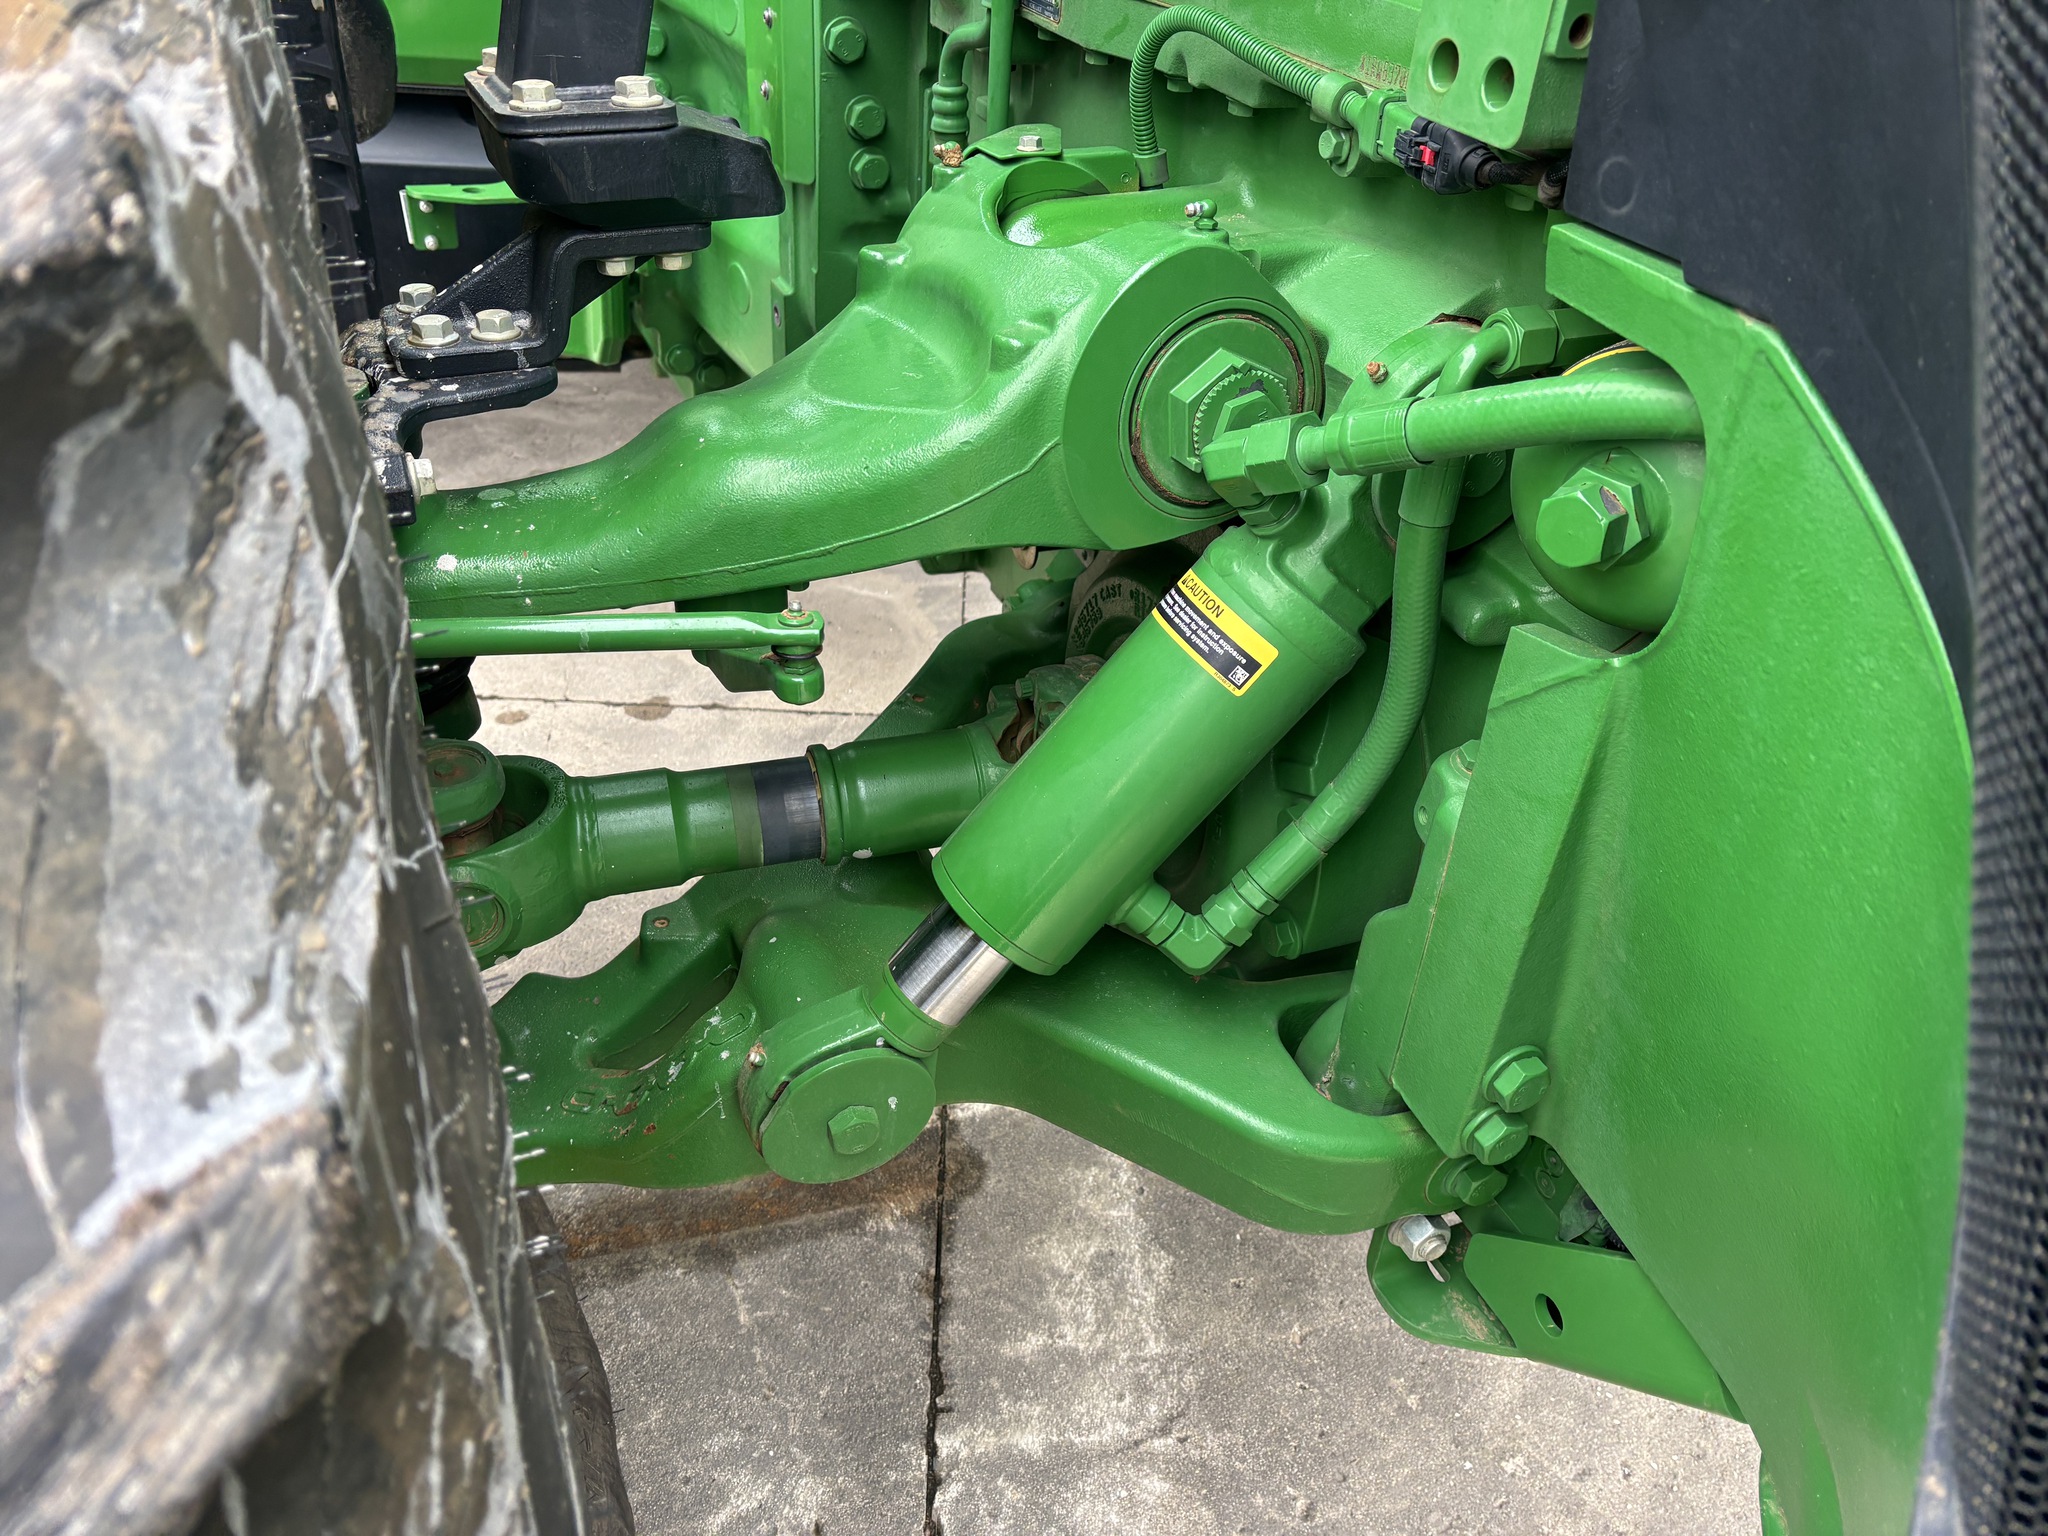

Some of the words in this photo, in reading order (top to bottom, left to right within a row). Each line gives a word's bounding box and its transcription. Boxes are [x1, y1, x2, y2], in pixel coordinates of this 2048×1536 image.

[1100, 583, 1121, 601] CAST
[1185, 578, 1224, 618] CAUTION
[1172, 615, 1192, 637] servicing
[1190, 633, 1209, 654] system.
[1177, 609, 1192, 624] dealer
[1189, 621, 1197, 631] for
[1195, 627, 1224, 656] instruction
[1183, 605, 1209, 630] movement
[1207, 628, 1220, 640] and
[1218, 638, 1247, 665] exposure
